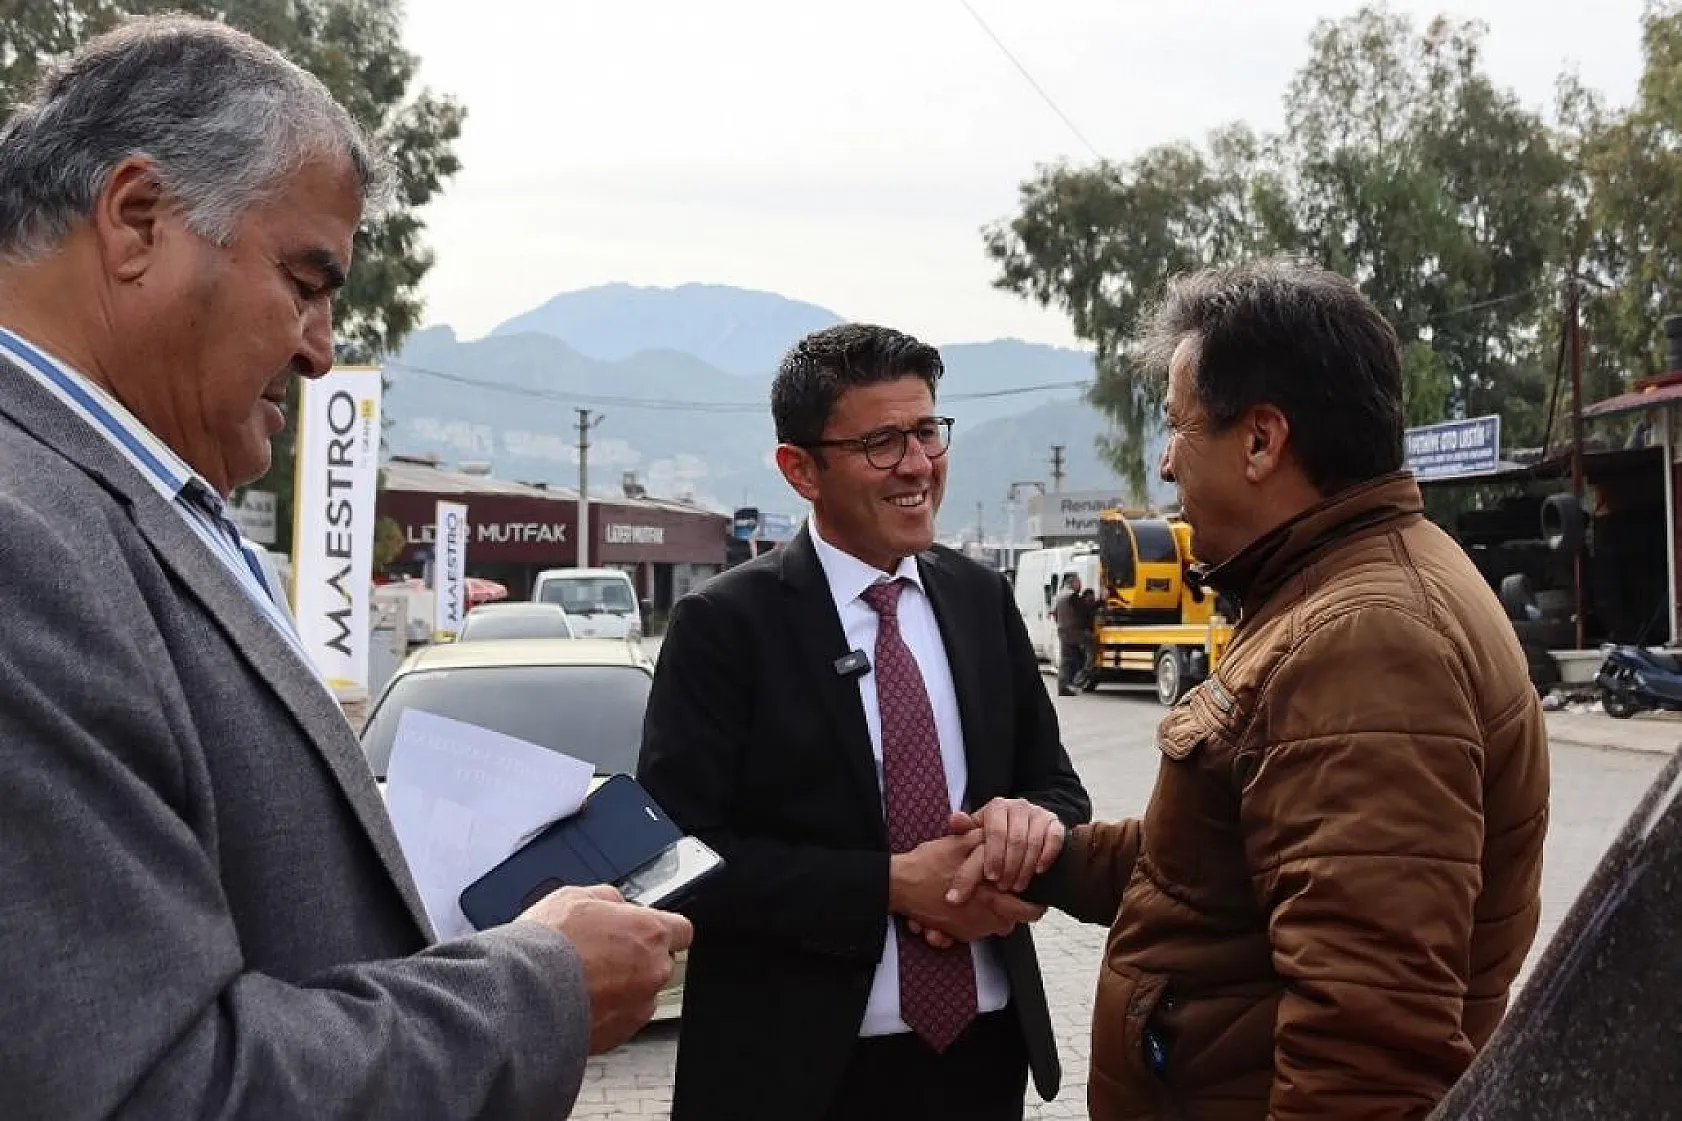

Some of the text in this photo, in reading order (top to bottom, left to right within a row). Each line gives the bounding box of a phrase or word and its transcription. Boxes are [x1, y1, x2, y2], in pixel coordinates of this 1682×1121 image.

[324, 389, 356, 657] MAESTRO
[446, 511, 458, 622] MAESTRO
[478, 523, 567, 542] MUTFAK
